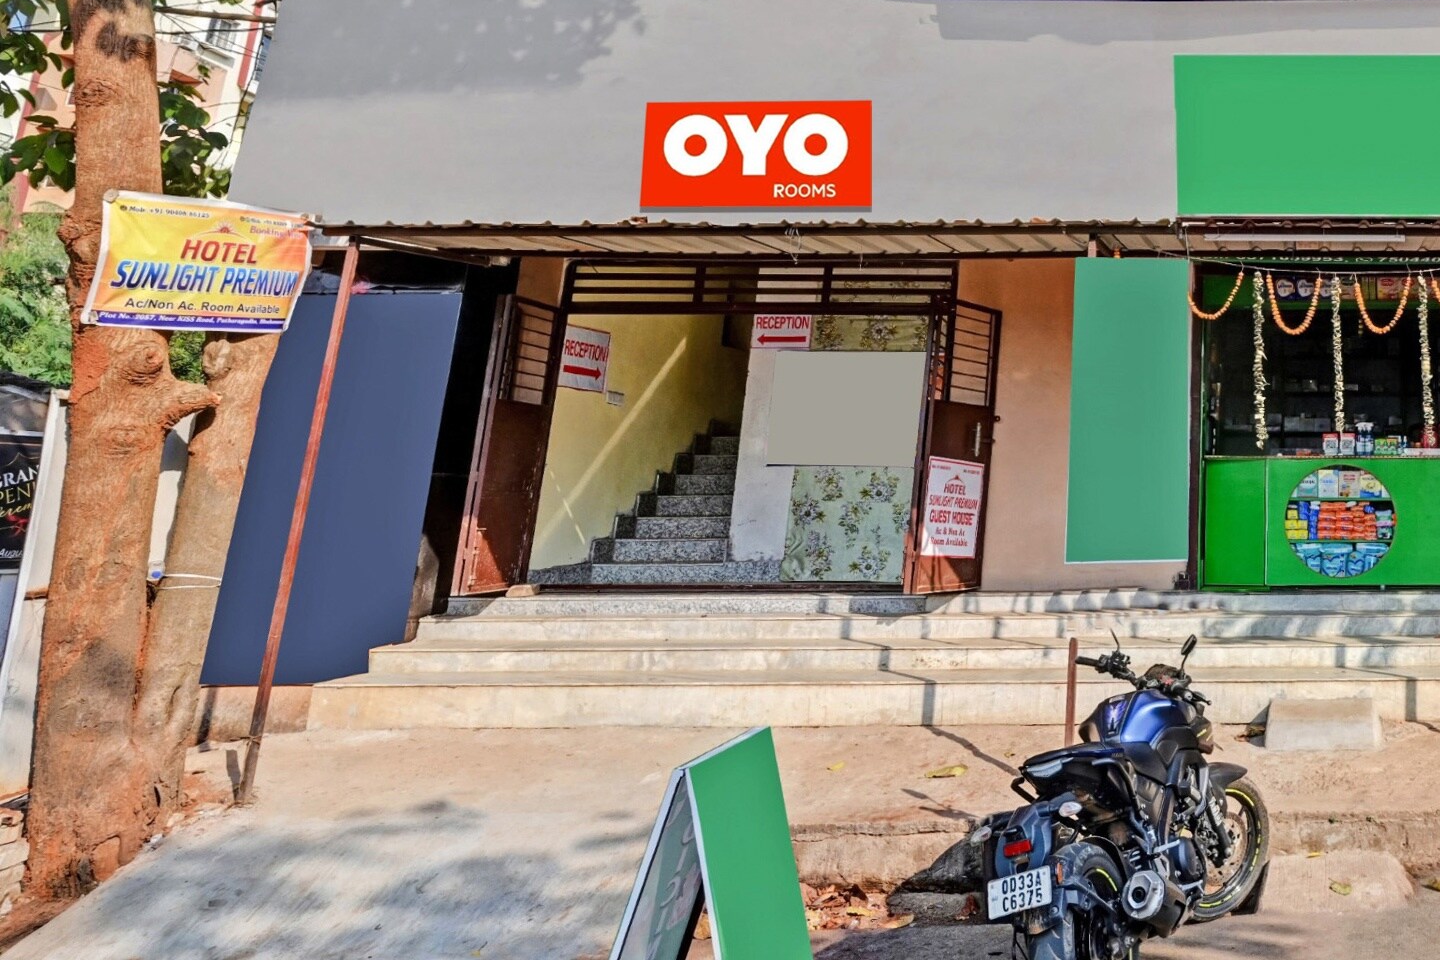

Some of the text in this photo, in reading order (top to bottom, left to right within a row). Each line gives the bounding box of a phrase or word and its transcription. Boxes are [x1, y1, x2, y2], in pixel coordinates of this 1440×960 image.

[663, 113, 849, 177] OYO
[773, 183, 837, 199] ROOMS
[180, 239, 258, 265] HOTEL
[110, 260, 300, 297] SUNLIGHT PREMIUM
[124, 297, 281, 315] Ac/Non Ac. Room Available
[755, 315, 810, 330] RECEPTION
[563, 339, 609, 363] RECEPTION
[943, 482, 967, 496] HOTEL
[929, 509, 975, 526] GUEST HOUSE
[1001, 870, 1042, 895] OD33A
[1002, 887, 1043, 913] C6375
